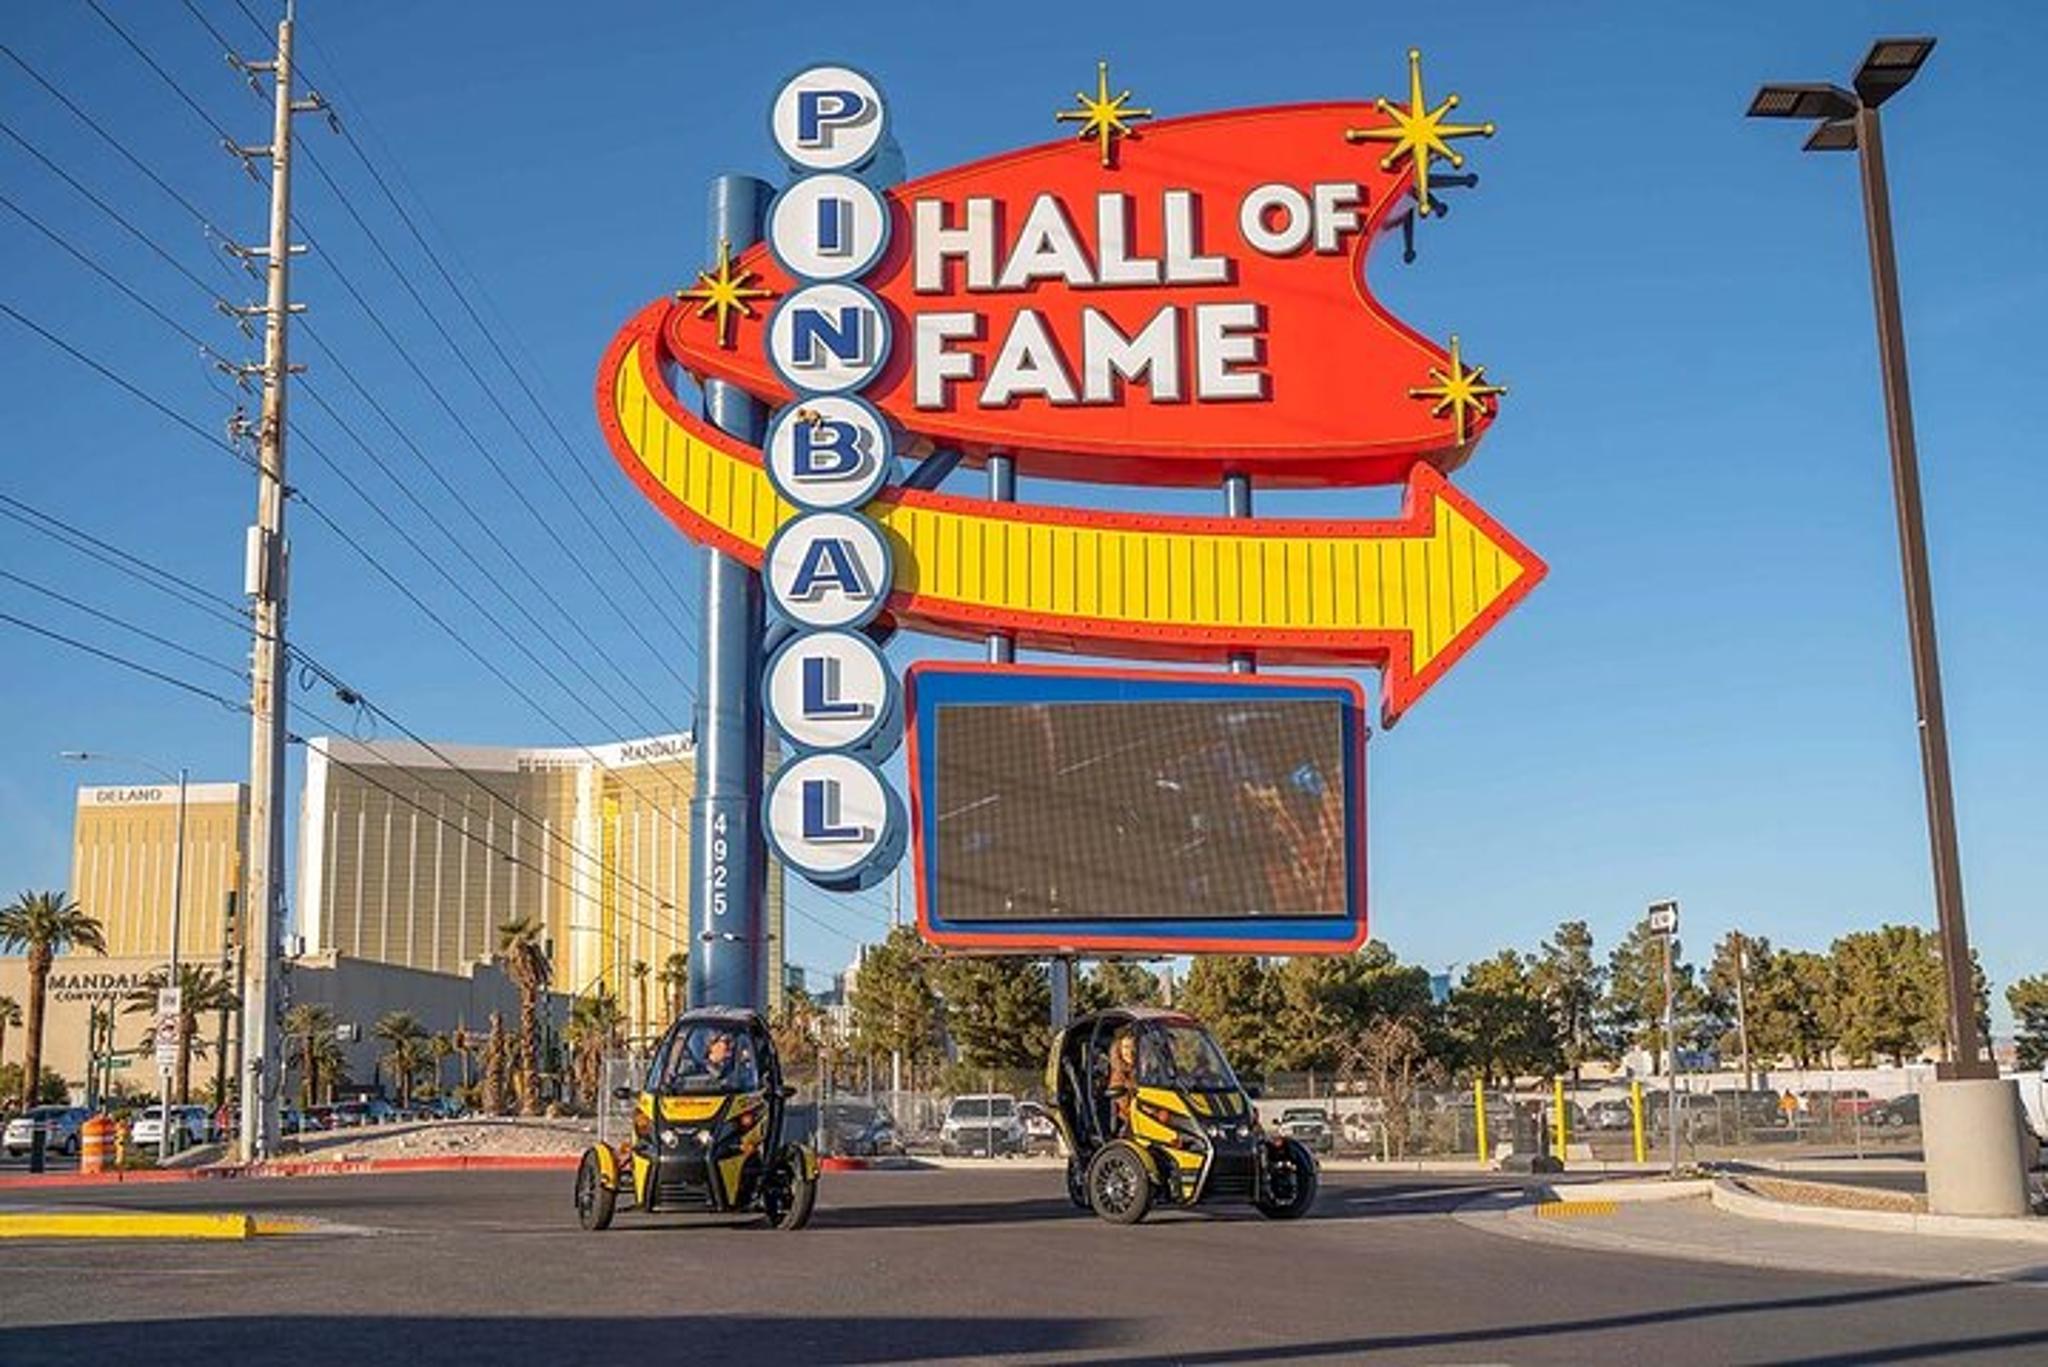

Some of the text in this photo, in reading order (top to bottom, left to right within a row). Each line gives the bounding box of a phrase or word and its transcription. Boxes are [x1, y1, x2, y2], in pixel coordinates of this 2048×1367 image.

[914, 182, 1361, 292] HALL OF
[914, 303, 1270, 408] FAME
[789, 89, 877, 845] PINBALL
[96, 788, 162, 803] DELANO
[714, 812, 727, 916] 4925
[48, 973, 168, 990] MANDAL
